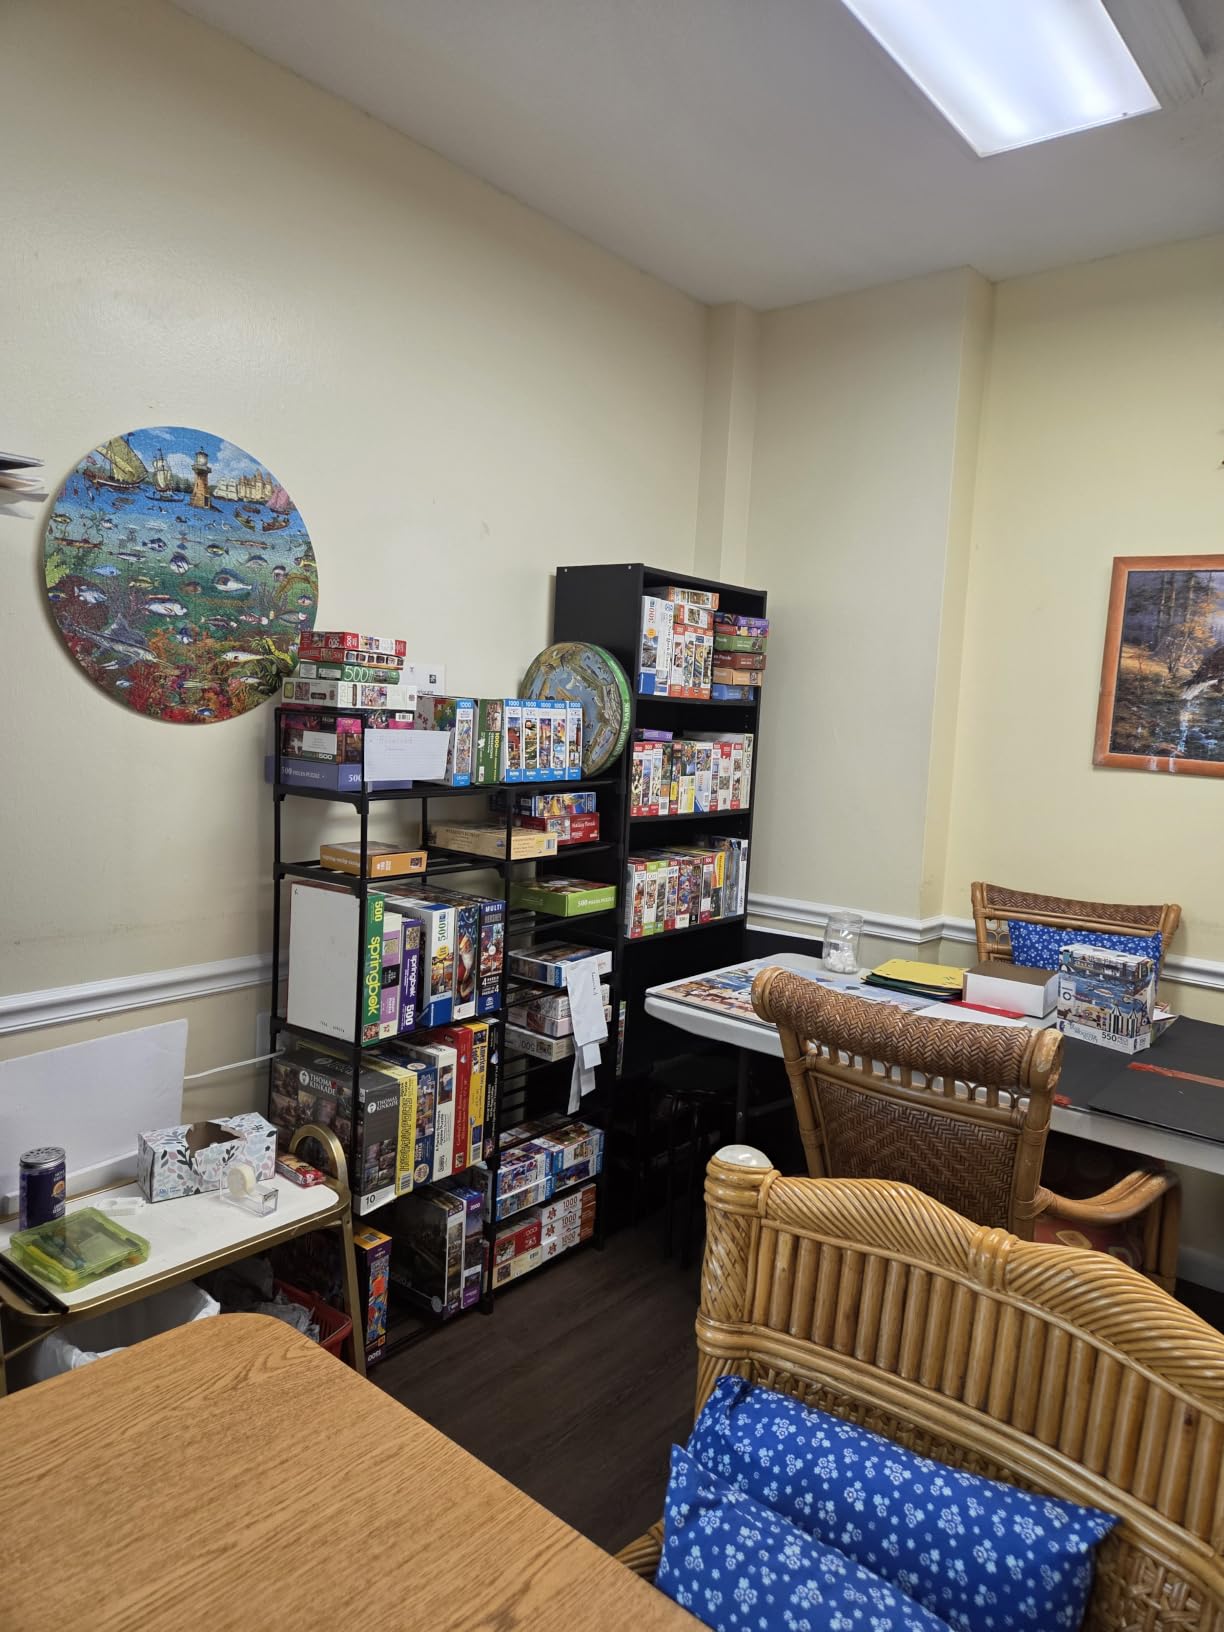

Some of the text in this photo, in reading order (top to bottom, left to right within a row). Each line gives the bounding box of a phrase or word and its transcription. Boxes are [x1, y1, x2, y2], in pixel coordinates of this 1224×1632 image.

[344, 666, 369, 683] 500
[374, 901, 383, 922] 500
[485, 903, 502, 912] MULTI
[365, 936, 382, 1016] springbok
[405, 1003, 415, 1026] 500
[1101, 1031, 1117, 1042] 550
[521, 1040, 536, 1052] 500
[376, 1096, 398, 1106] THOMAS
[376, 1101, 398, 1111] KINKADE
[365, 1194, 376, 1206] 10
[562, 1196, 578, 1209] 1000
[469, 1202, 481, 1211] 2000
[561, 1213, 577, 1225] 1000
